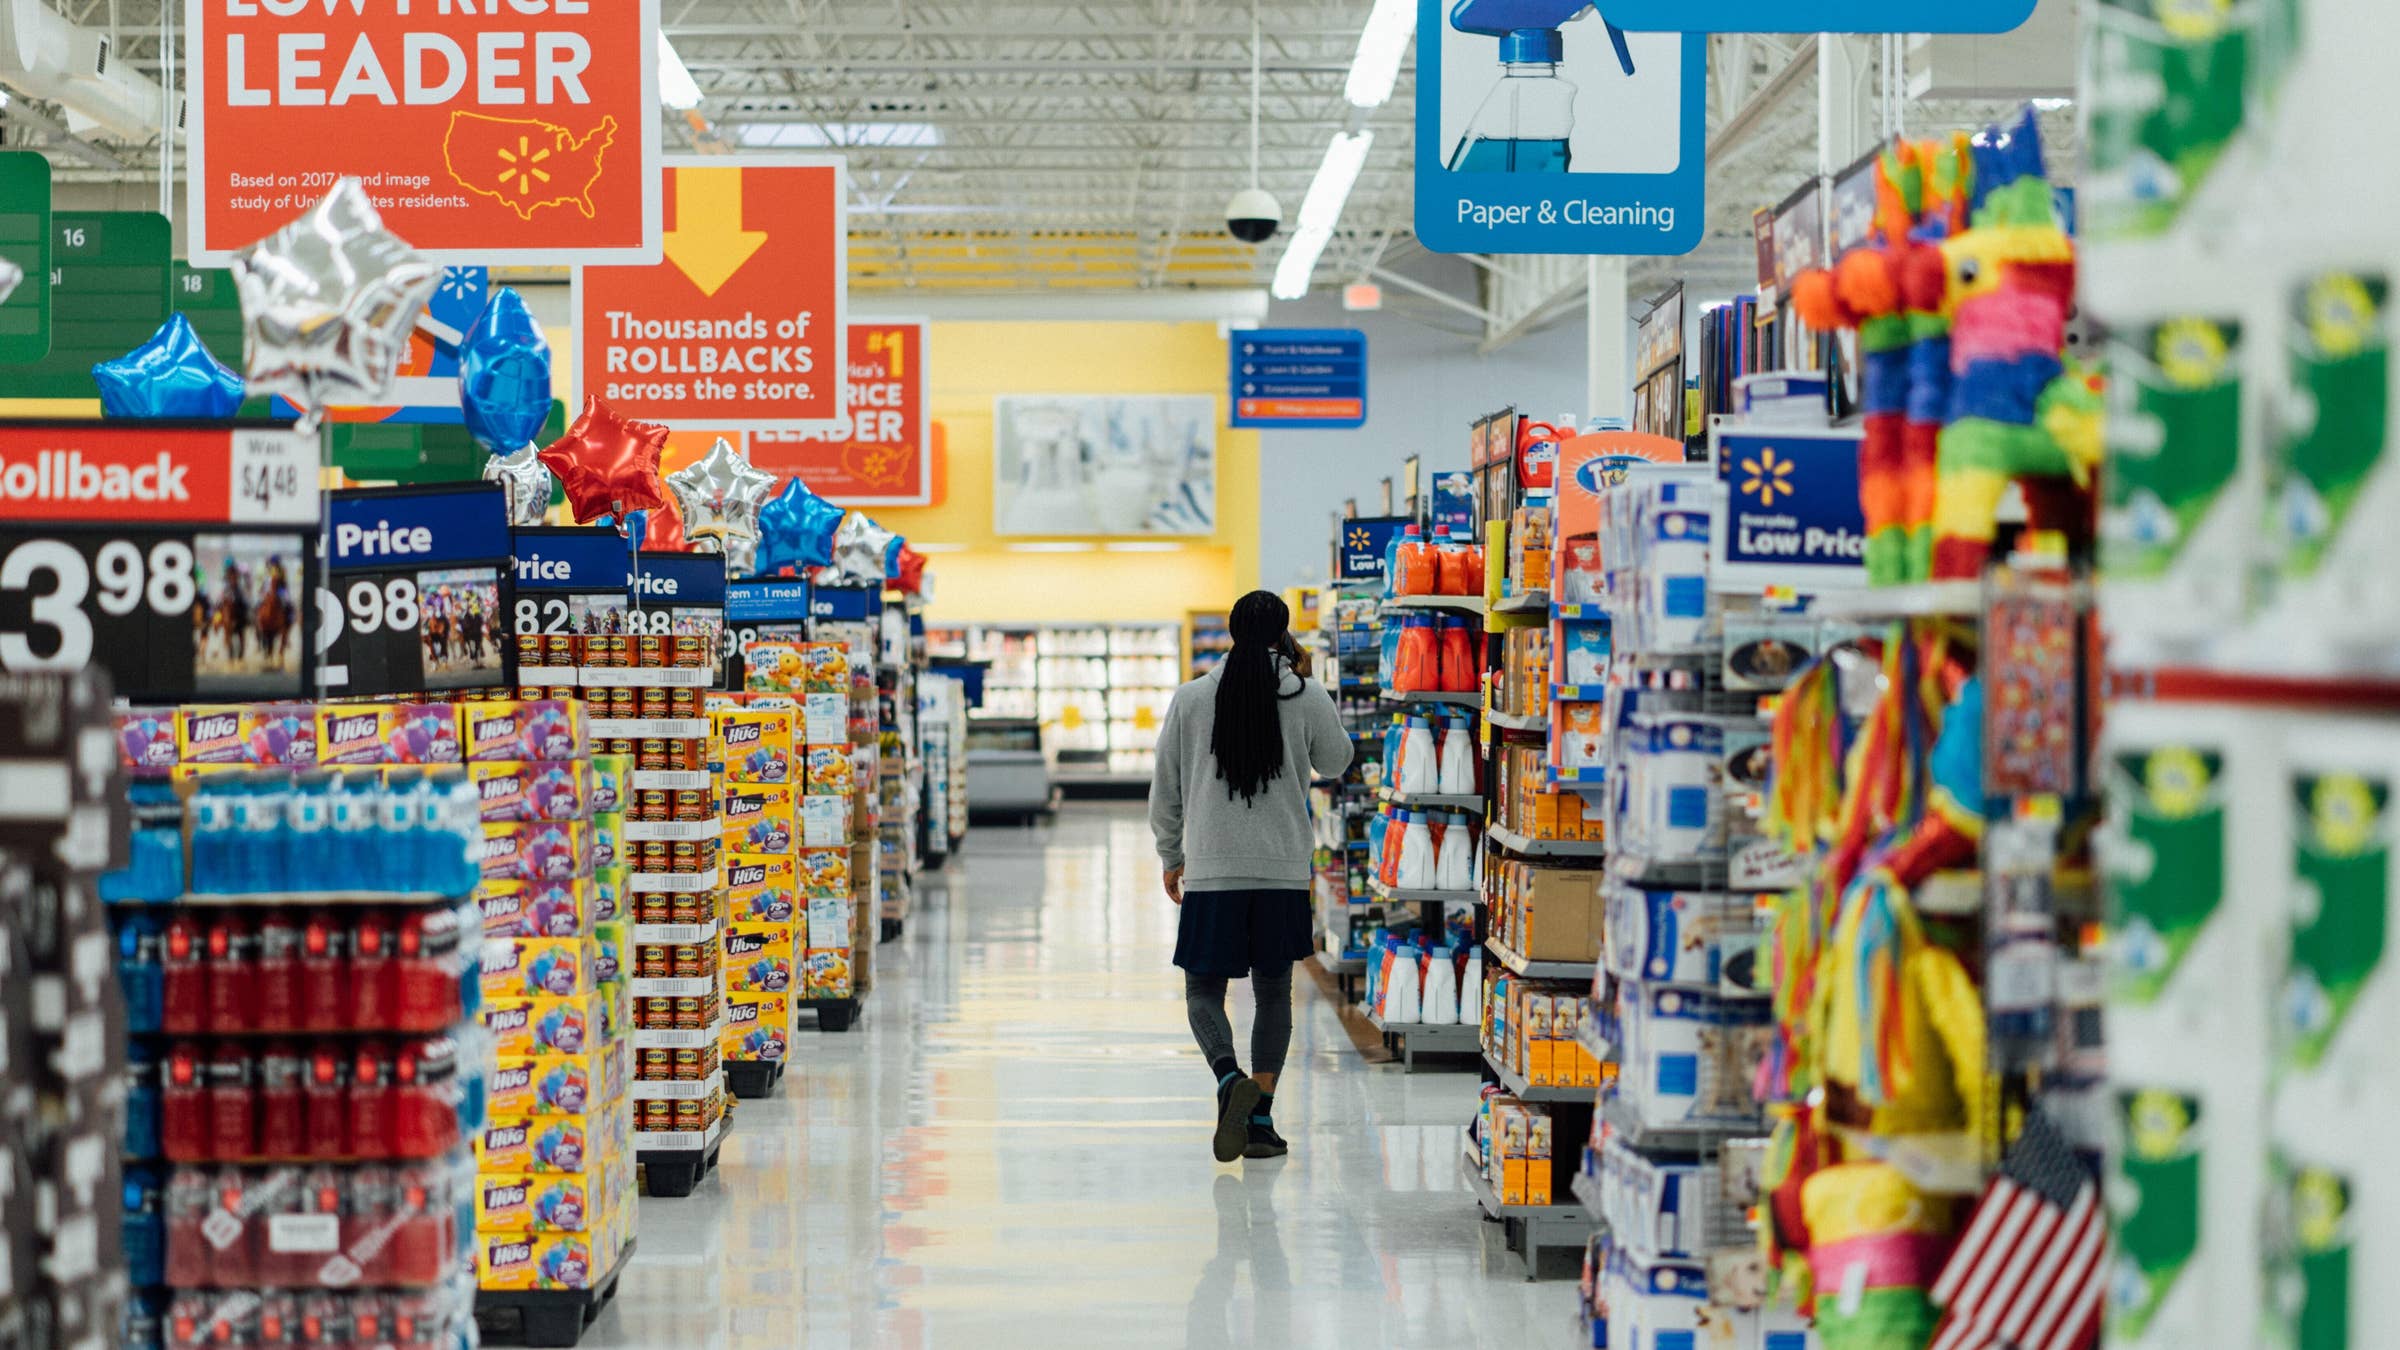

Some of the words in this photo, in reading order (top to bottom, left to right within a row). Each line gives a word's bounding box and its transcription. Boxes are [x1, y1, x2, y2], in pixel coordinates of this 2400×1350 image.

[227, 32, 592, 106] LEADER
[230, 173, 274, 188] Based
[278, 177, 297, 187] on
[301, 173, 335, 187] 2017
[386, 172, 430, 189] image
[230, 195, 269, 212] study
[274, 195, 291, 208] of
[399, 195, 470, 208] residents.
[1457, 200, 1531, 229] Paper
[1537, 200, 1558, 225] &
[1563, 200, 1676, 231] Cleaning
[64, 228, 86, 247] 16
[182, 275, 202, 293] 18
[605, 311, 768, 340] Thousands
[776, 311, 812, 340] of
[606, 346, 813, 374] ROLLBACKS
[867, 331, 904, 378] #1
[606, 380, 686, 401] across
[694, 376, 737, 401] the
[744, 378, 815, 401] store.
[336, 520, 433, 557] Price
[1738, 528, 1801, 555] Low
[1805, 527, 1868, 556] Pric
[1350, 561, 1376, 571] Low
[771, 586, 801, 599] meal
[195, 716, 237, 742] HUG
[334, 717, 377, 743] HUG
[479, 718, 514, 740] HUG
[728, 726, 759, 744] HUG
[764, 723, 776, 731] 40
[765, 760, 784, 770] 75%
[484, 777, 519, 799] HUG
[766, 794, 778, 802] 40
[767, 832, 786, 841] 75%
[485, 838, 517, 858] HUG
[733, 868, 764, 886] HUG
[768, 864, 781, 873] 40
[485, 897, 519, 918] HUG
[770, 903, 789, 913] 75%
[766, 971, 786, 981] 75%
[728, 1006, 757, 1023] HUG
[761, 1002, 774, 1011] 40
[491, 1011, 526, 1031] HUG
[762, 1040, 782, 1050] 75%
[494, 1070, 528, 1091] HUG
[489, 1128, 524, 1149] HUG
[489, 1188, 524, 1209] HUG
[494, 1245, 529, 1266] HUG
